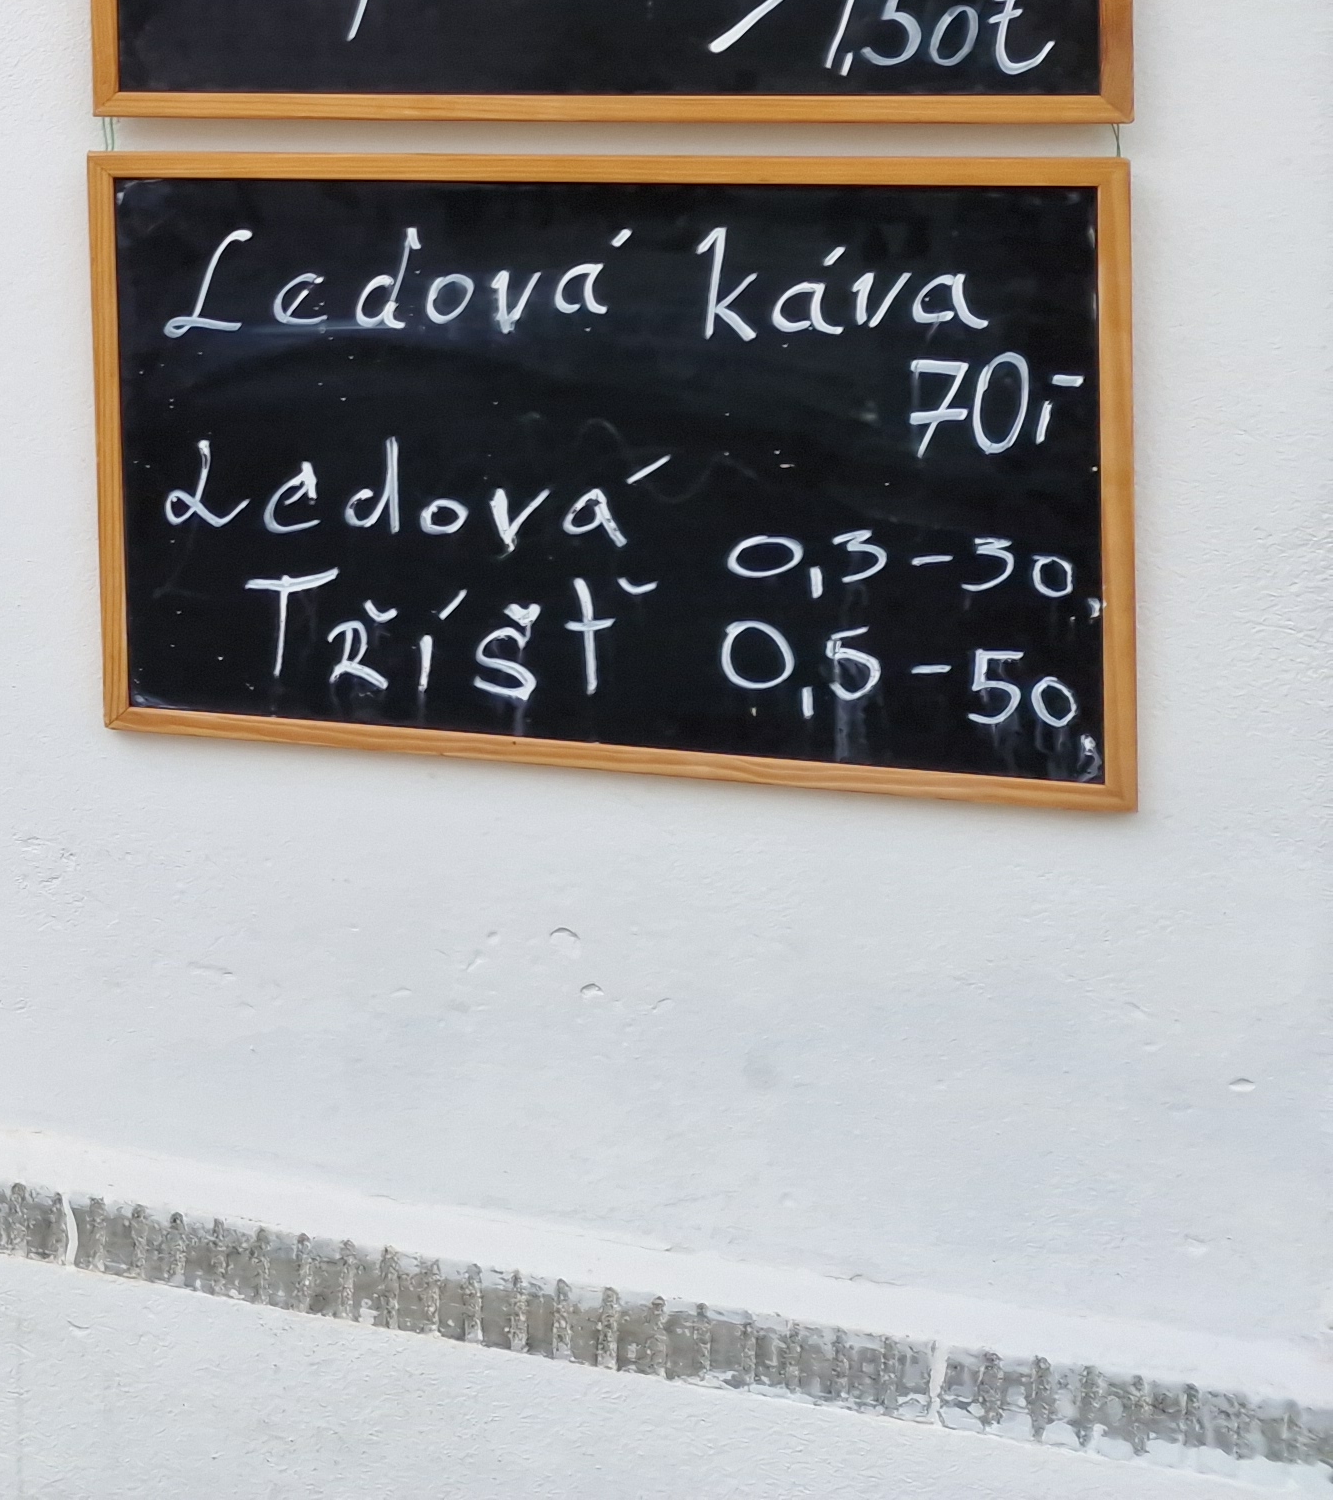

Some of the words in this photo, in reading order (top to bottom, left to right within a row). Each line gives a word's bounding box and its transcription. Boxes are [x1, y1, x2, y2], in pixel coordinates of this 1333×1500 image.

[164, 227, 633, 339] Ledová
[696, 227, 989, 342] káva
[164, 436, 672, 557] Ledová
